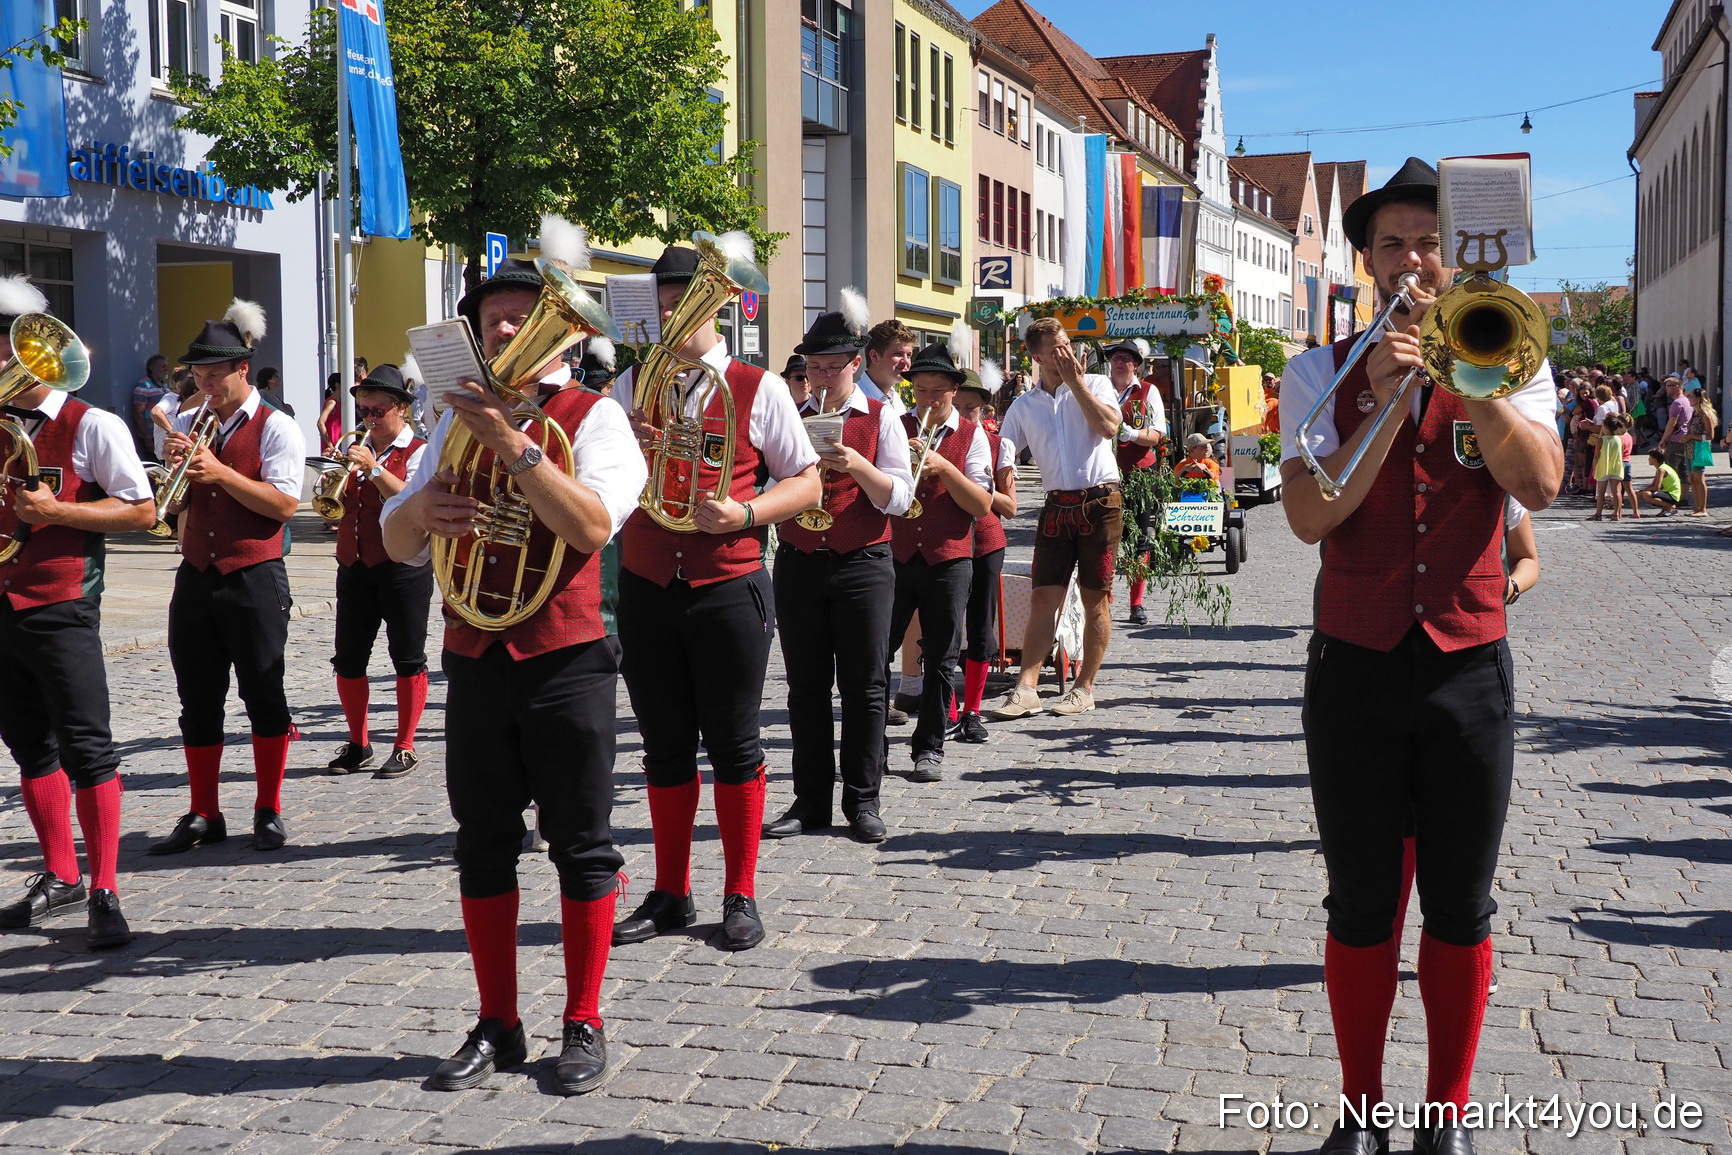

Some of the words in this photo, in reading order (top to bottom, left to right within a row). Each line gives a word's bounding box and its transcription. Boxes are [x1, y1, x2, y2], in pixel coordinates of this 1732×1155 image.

[69, 140, 275, 211] aiffeisenbank
[491, 240, 503, 276] P
[1105, 307, 1190, 324] Schreinerinnung
[1105, 320, 1156, 336] Neumarkt
[1234, 447, 1258, 461] nung
[1460, 455, 1484, 467] PILSAC
[1167, 509, 1215, 522] Schreiner
[1167, 524, 1216, 533] MOBIL
